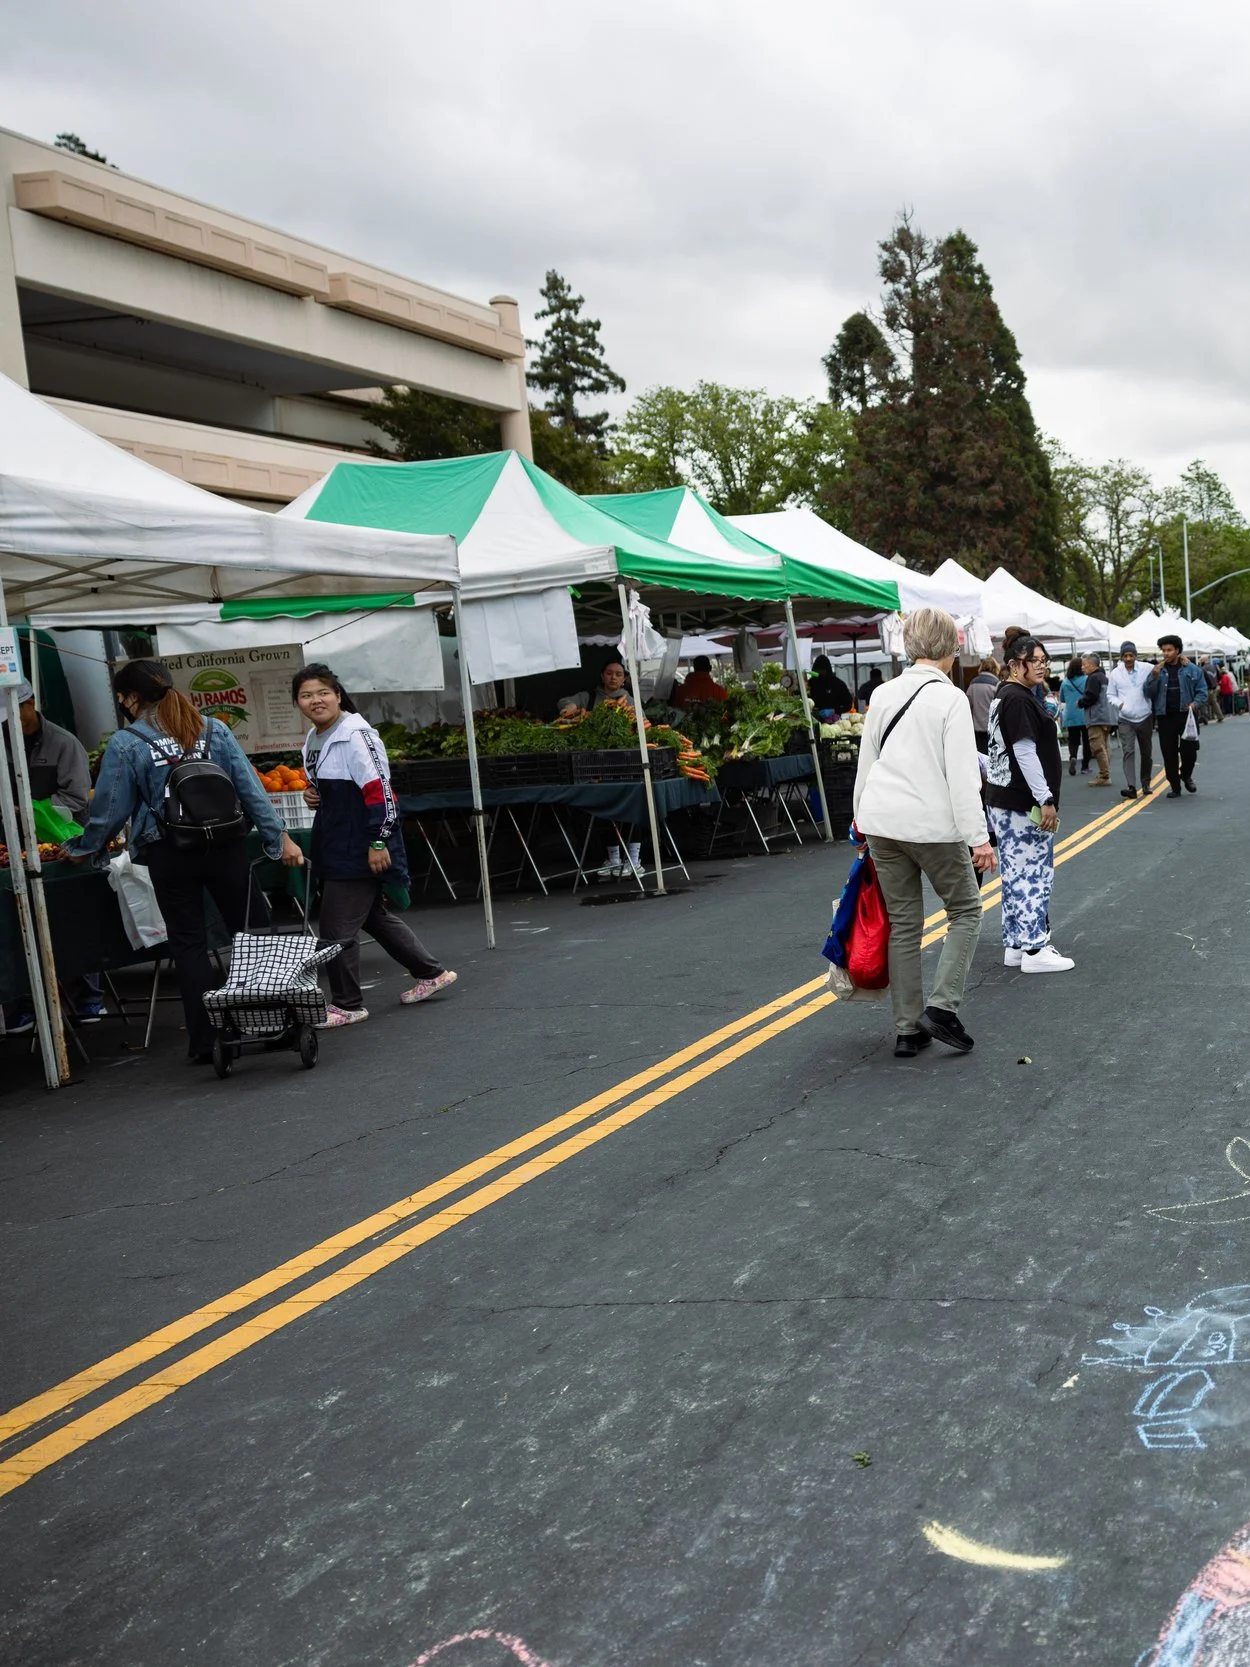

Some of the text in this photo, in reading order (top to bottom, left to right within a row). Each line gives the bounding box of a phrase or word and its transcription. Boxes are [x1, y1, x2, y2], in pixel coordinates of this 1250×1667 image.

[186, 652, 245, 669] California
[249, 650, 290, 662] Grown
[204, 688, 247, 705] RAMOS
[362, 730, 374, 748] TOMMY
[383, 780, 392, 800] TOMMY
